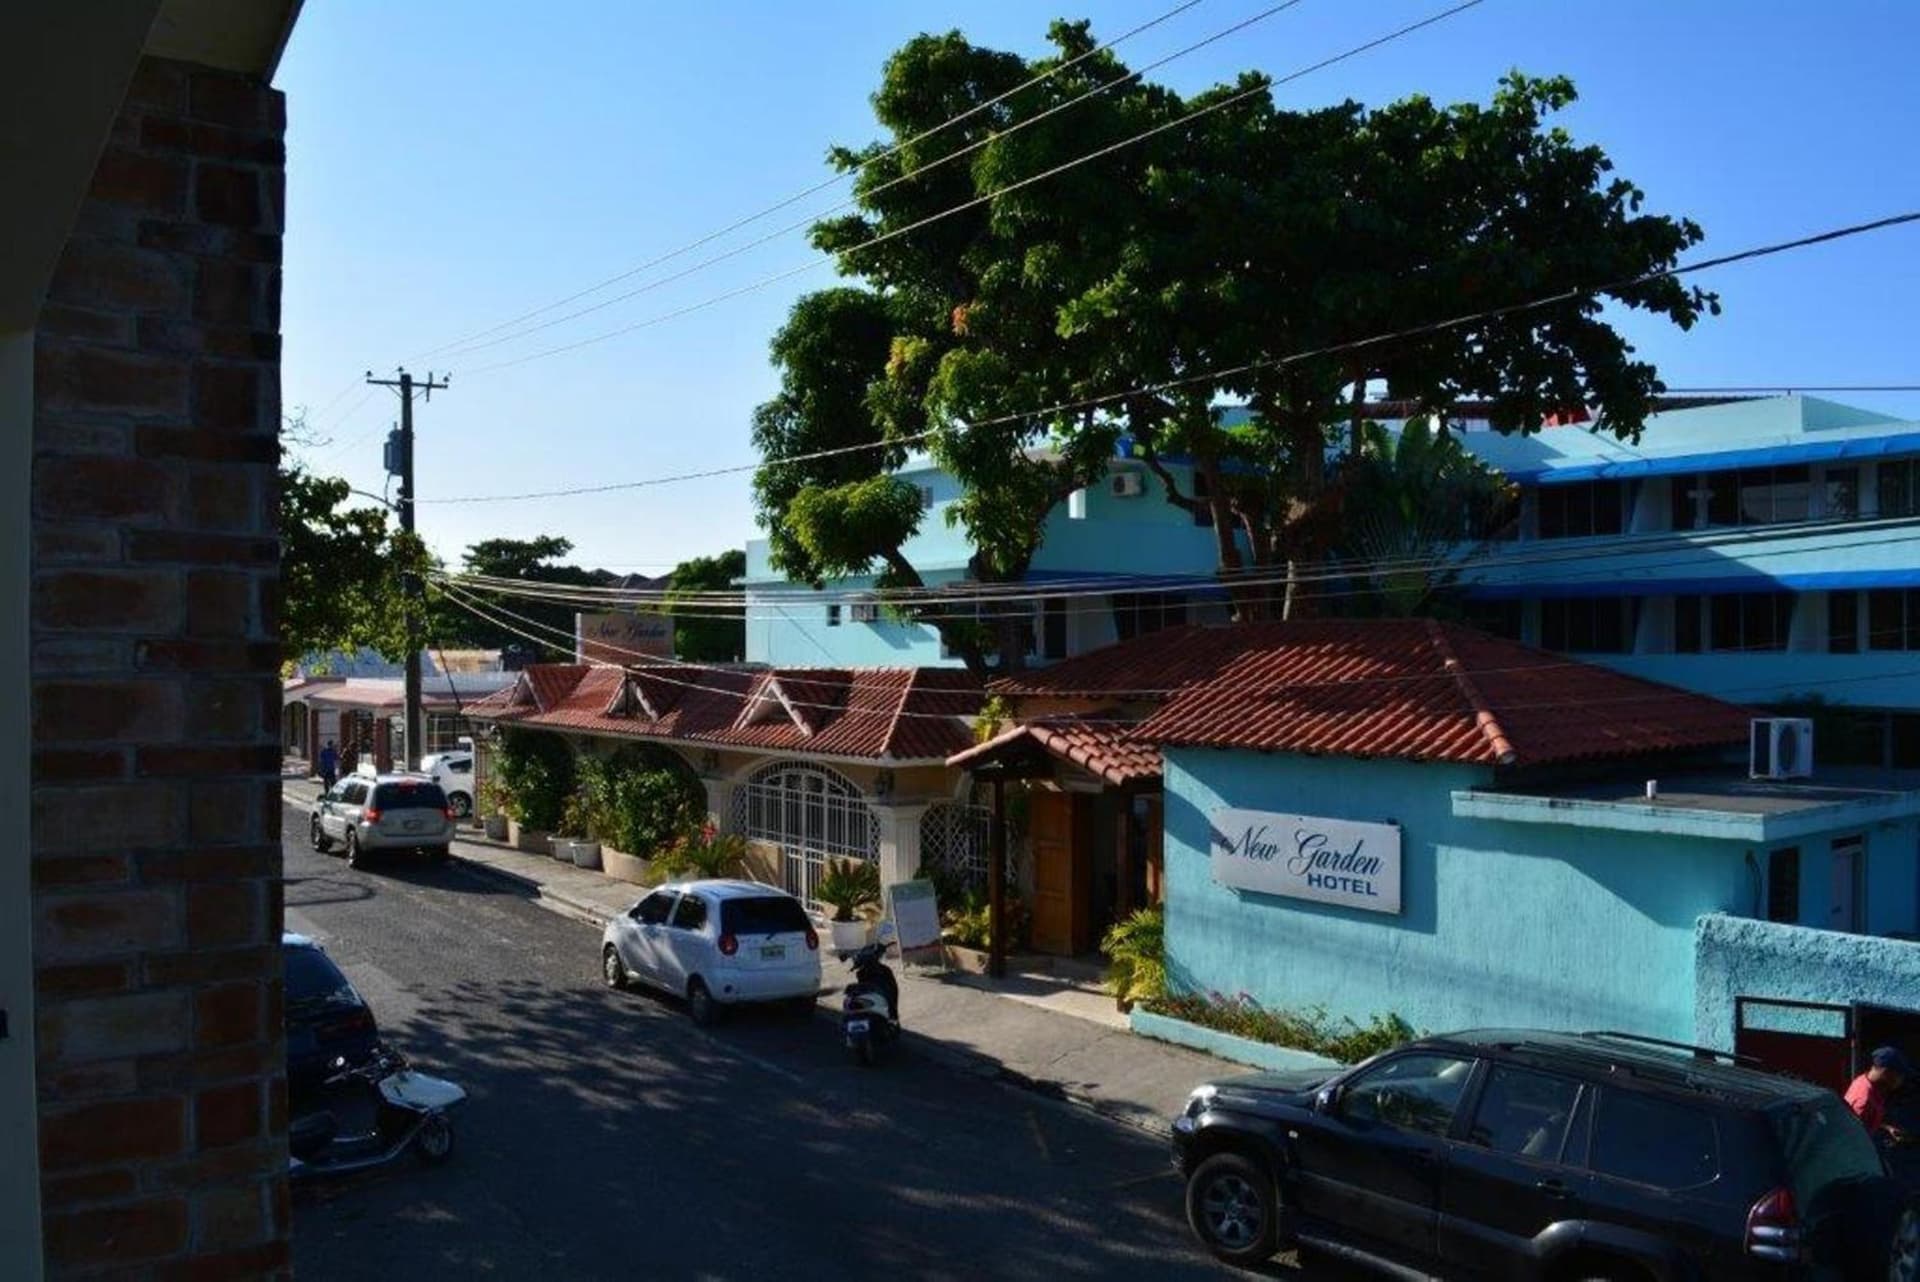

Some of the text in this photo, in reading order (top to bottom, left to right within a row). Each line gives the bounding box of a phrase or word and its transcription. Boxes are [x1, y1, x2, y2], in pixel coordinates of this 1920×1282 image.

[1229, 825, 1384, 876] New Garden
[1307, 873, 1379, 896] HOTEL
